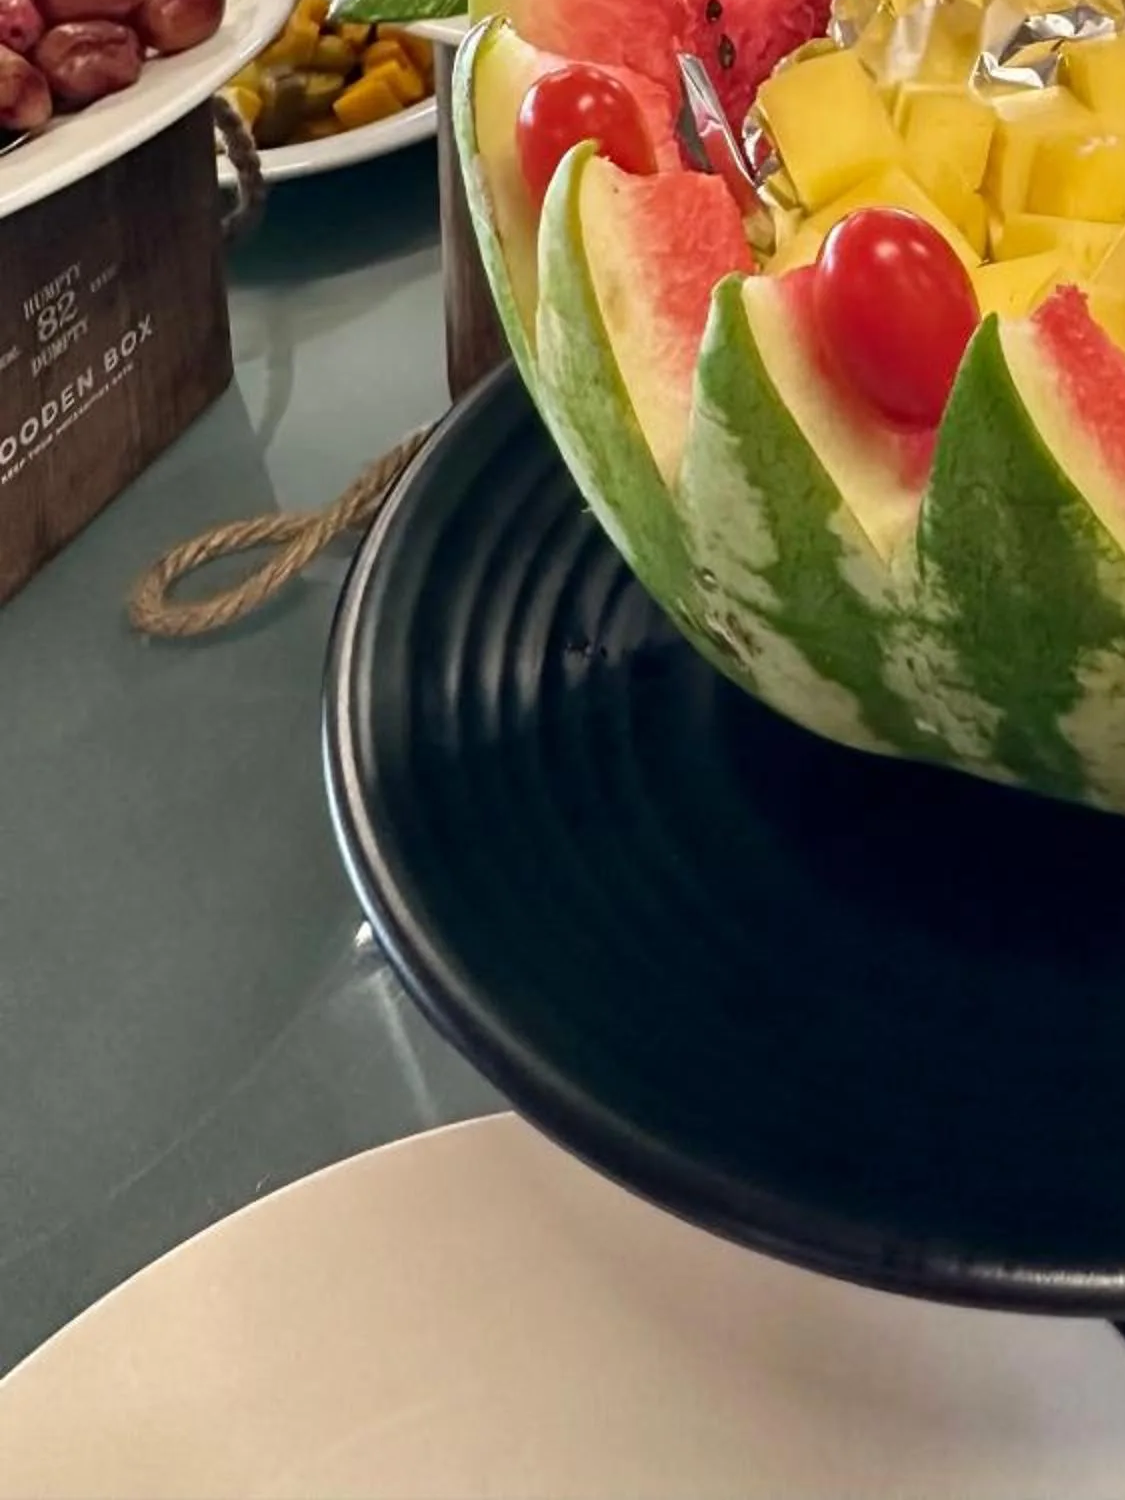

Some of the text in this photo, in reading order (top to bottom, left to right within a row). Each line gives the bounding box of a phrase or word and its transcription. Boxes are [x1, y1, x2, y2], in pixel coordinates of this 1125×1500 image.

[37, 290, 78, 342] 82
[0, 366, 94, 466] OODEN
[103, 313, 152, 373] BOX
